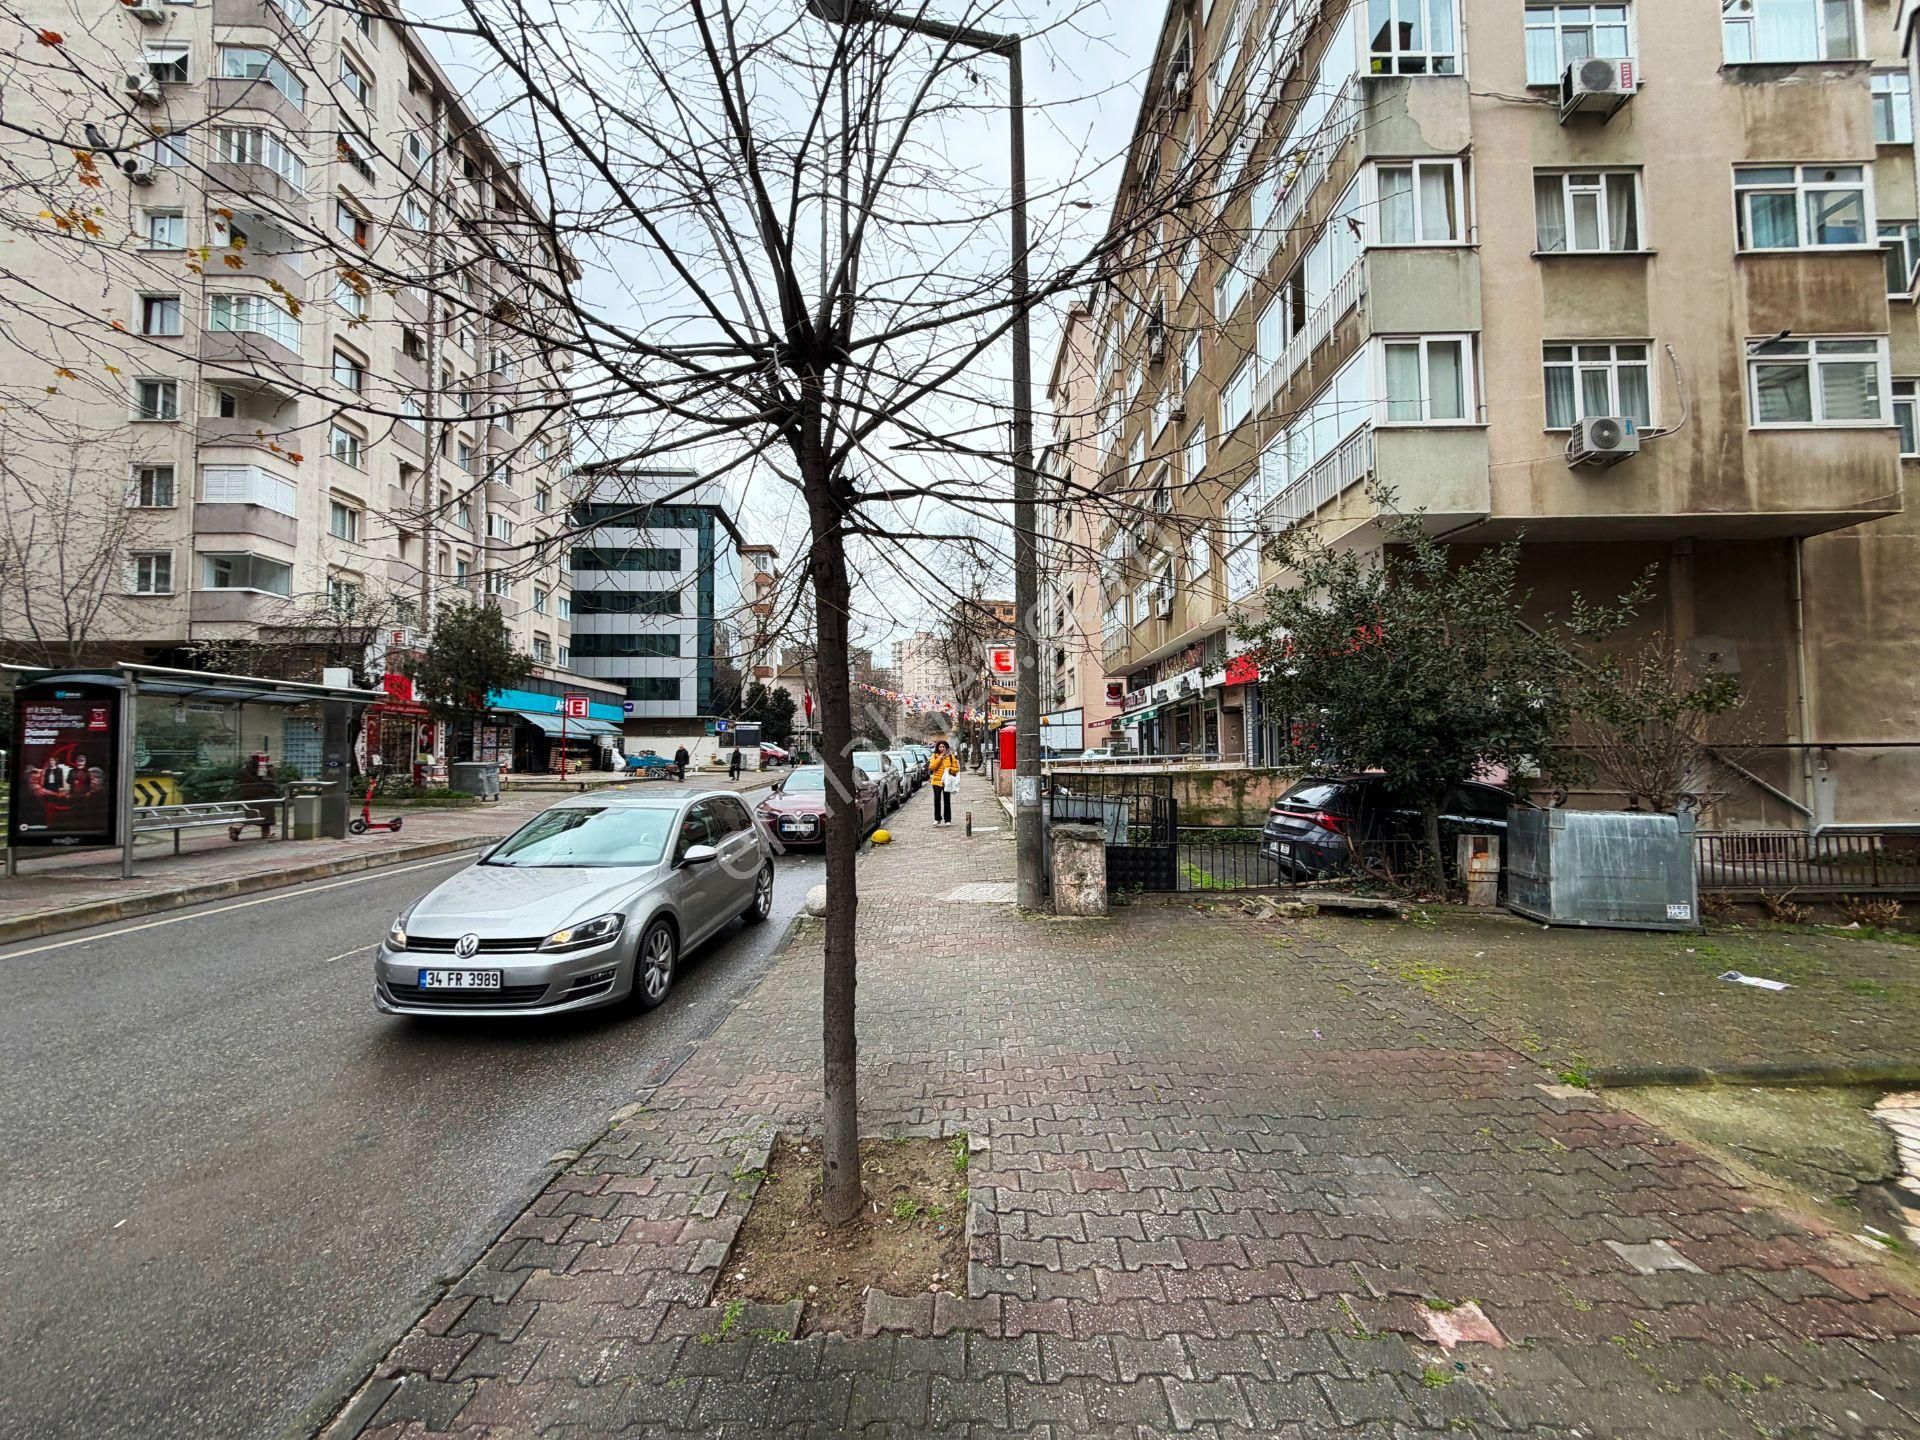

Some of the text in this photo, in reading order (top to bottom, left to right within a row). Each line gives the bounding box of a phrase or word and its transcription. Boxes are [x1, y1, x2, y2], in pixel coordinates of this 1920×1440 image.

[1622, 63, 1631, 88] VESTEL
[994, 651, 1011, 672] E
[573, 701, 582, 714] E
[427, 972, 498, 987] 34 FR 3989
